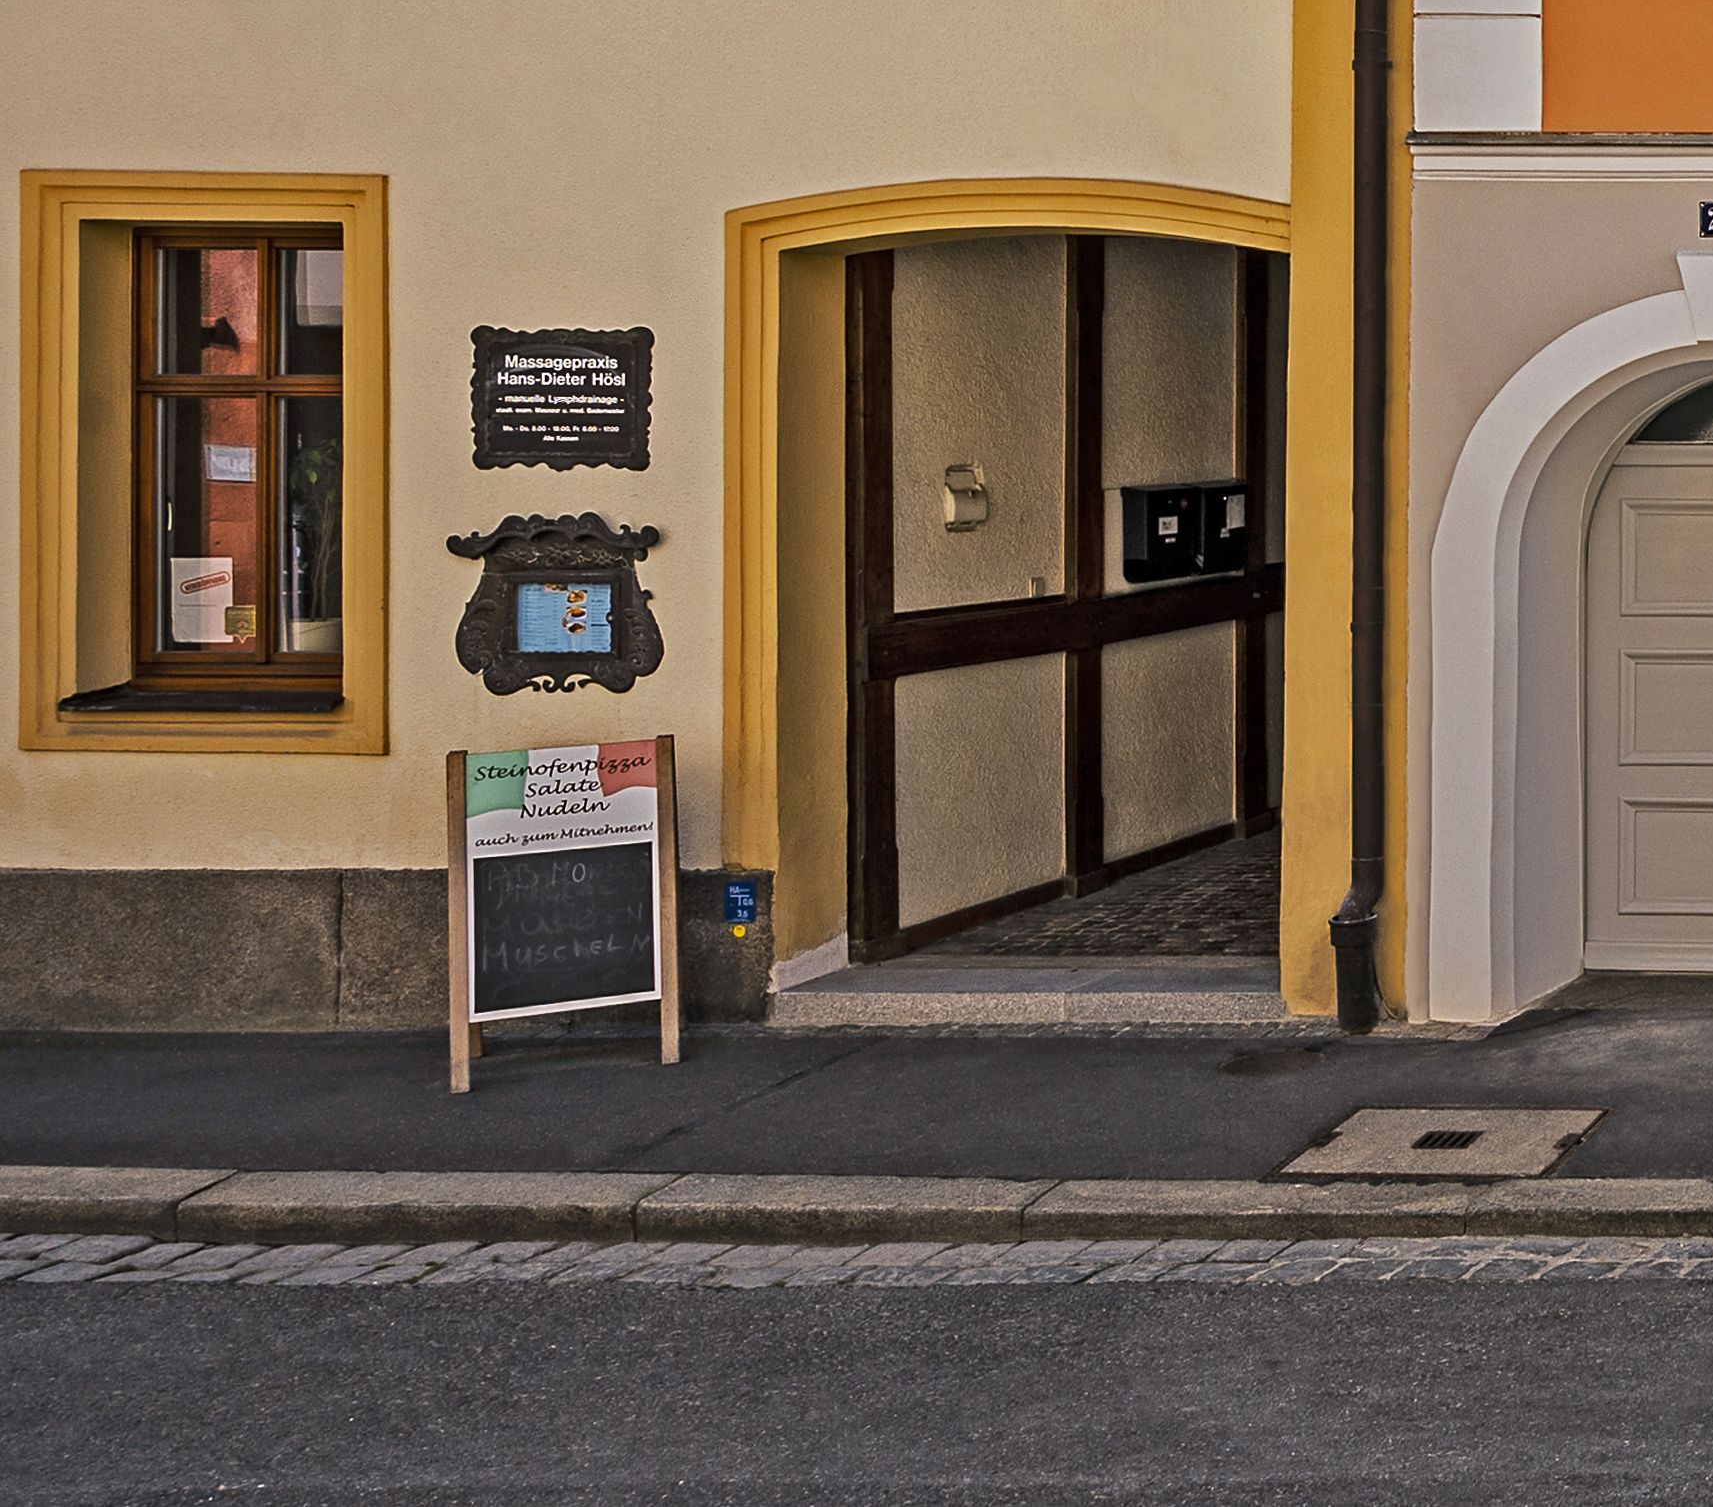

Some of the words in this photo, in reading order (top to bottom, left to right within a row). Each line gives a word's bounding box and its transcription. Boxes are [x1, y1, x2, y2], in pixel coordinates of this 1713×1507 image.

[504, 354, 619, 371] Massagepraxis
[497, 371, 587, 386] Hans-Dieter
[591, 372, 626, 386] Hösl
[548, 394, 618, 406] Lymphdrainage
[474, 755, 652, 782] Steinofenpizza
[525, 778, 603, 798] Salate
[520, 797, 611, 819] Nudeln
[475, 833, 519, 847] auch
[521, 831, 559, 845] zum
[559, 821, 654, 840] Mitnehmen!
